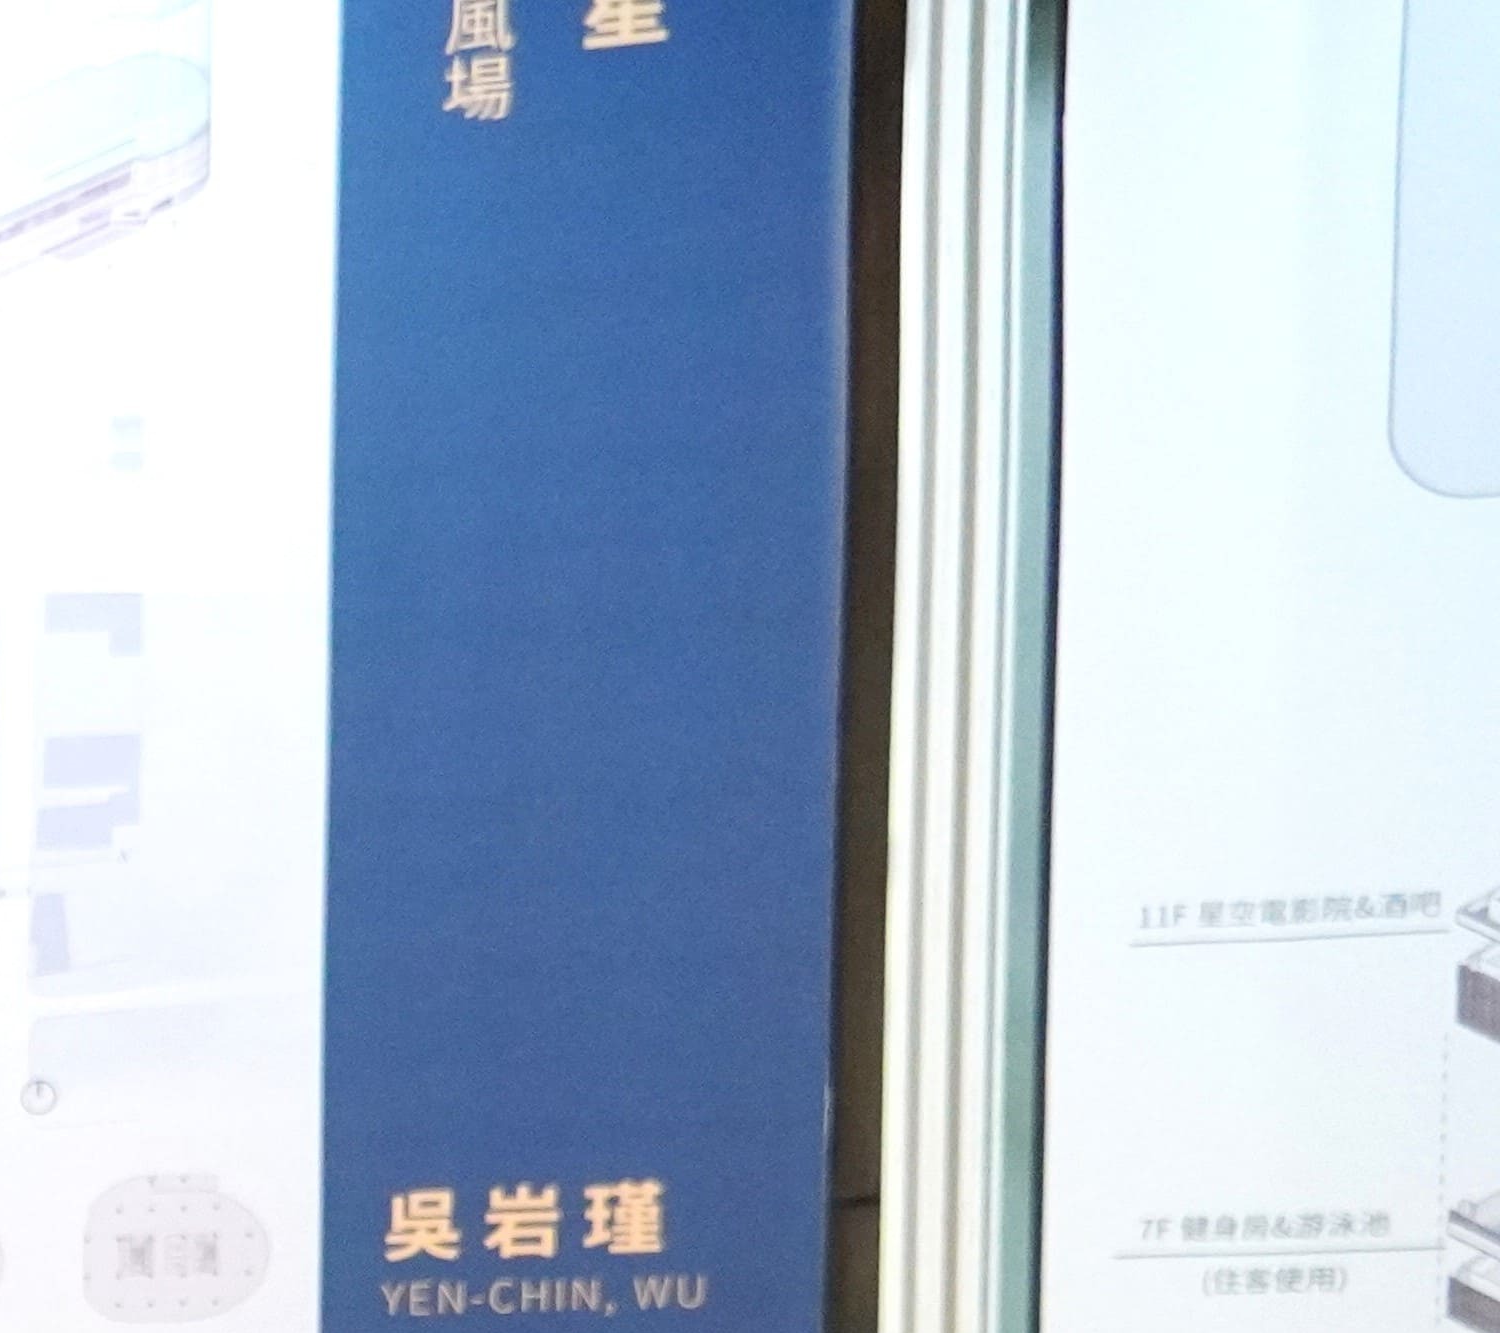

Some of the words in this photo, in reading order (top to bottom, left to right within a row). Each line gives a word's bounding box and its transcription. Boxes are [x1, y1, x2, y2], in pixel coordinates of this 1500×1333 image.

[384, 1176, 666, 1263] 吳岩瑾
[380, 1276, 617, 1318] YEN-CHIN,
[632, 1272, 707, 1311] WU
